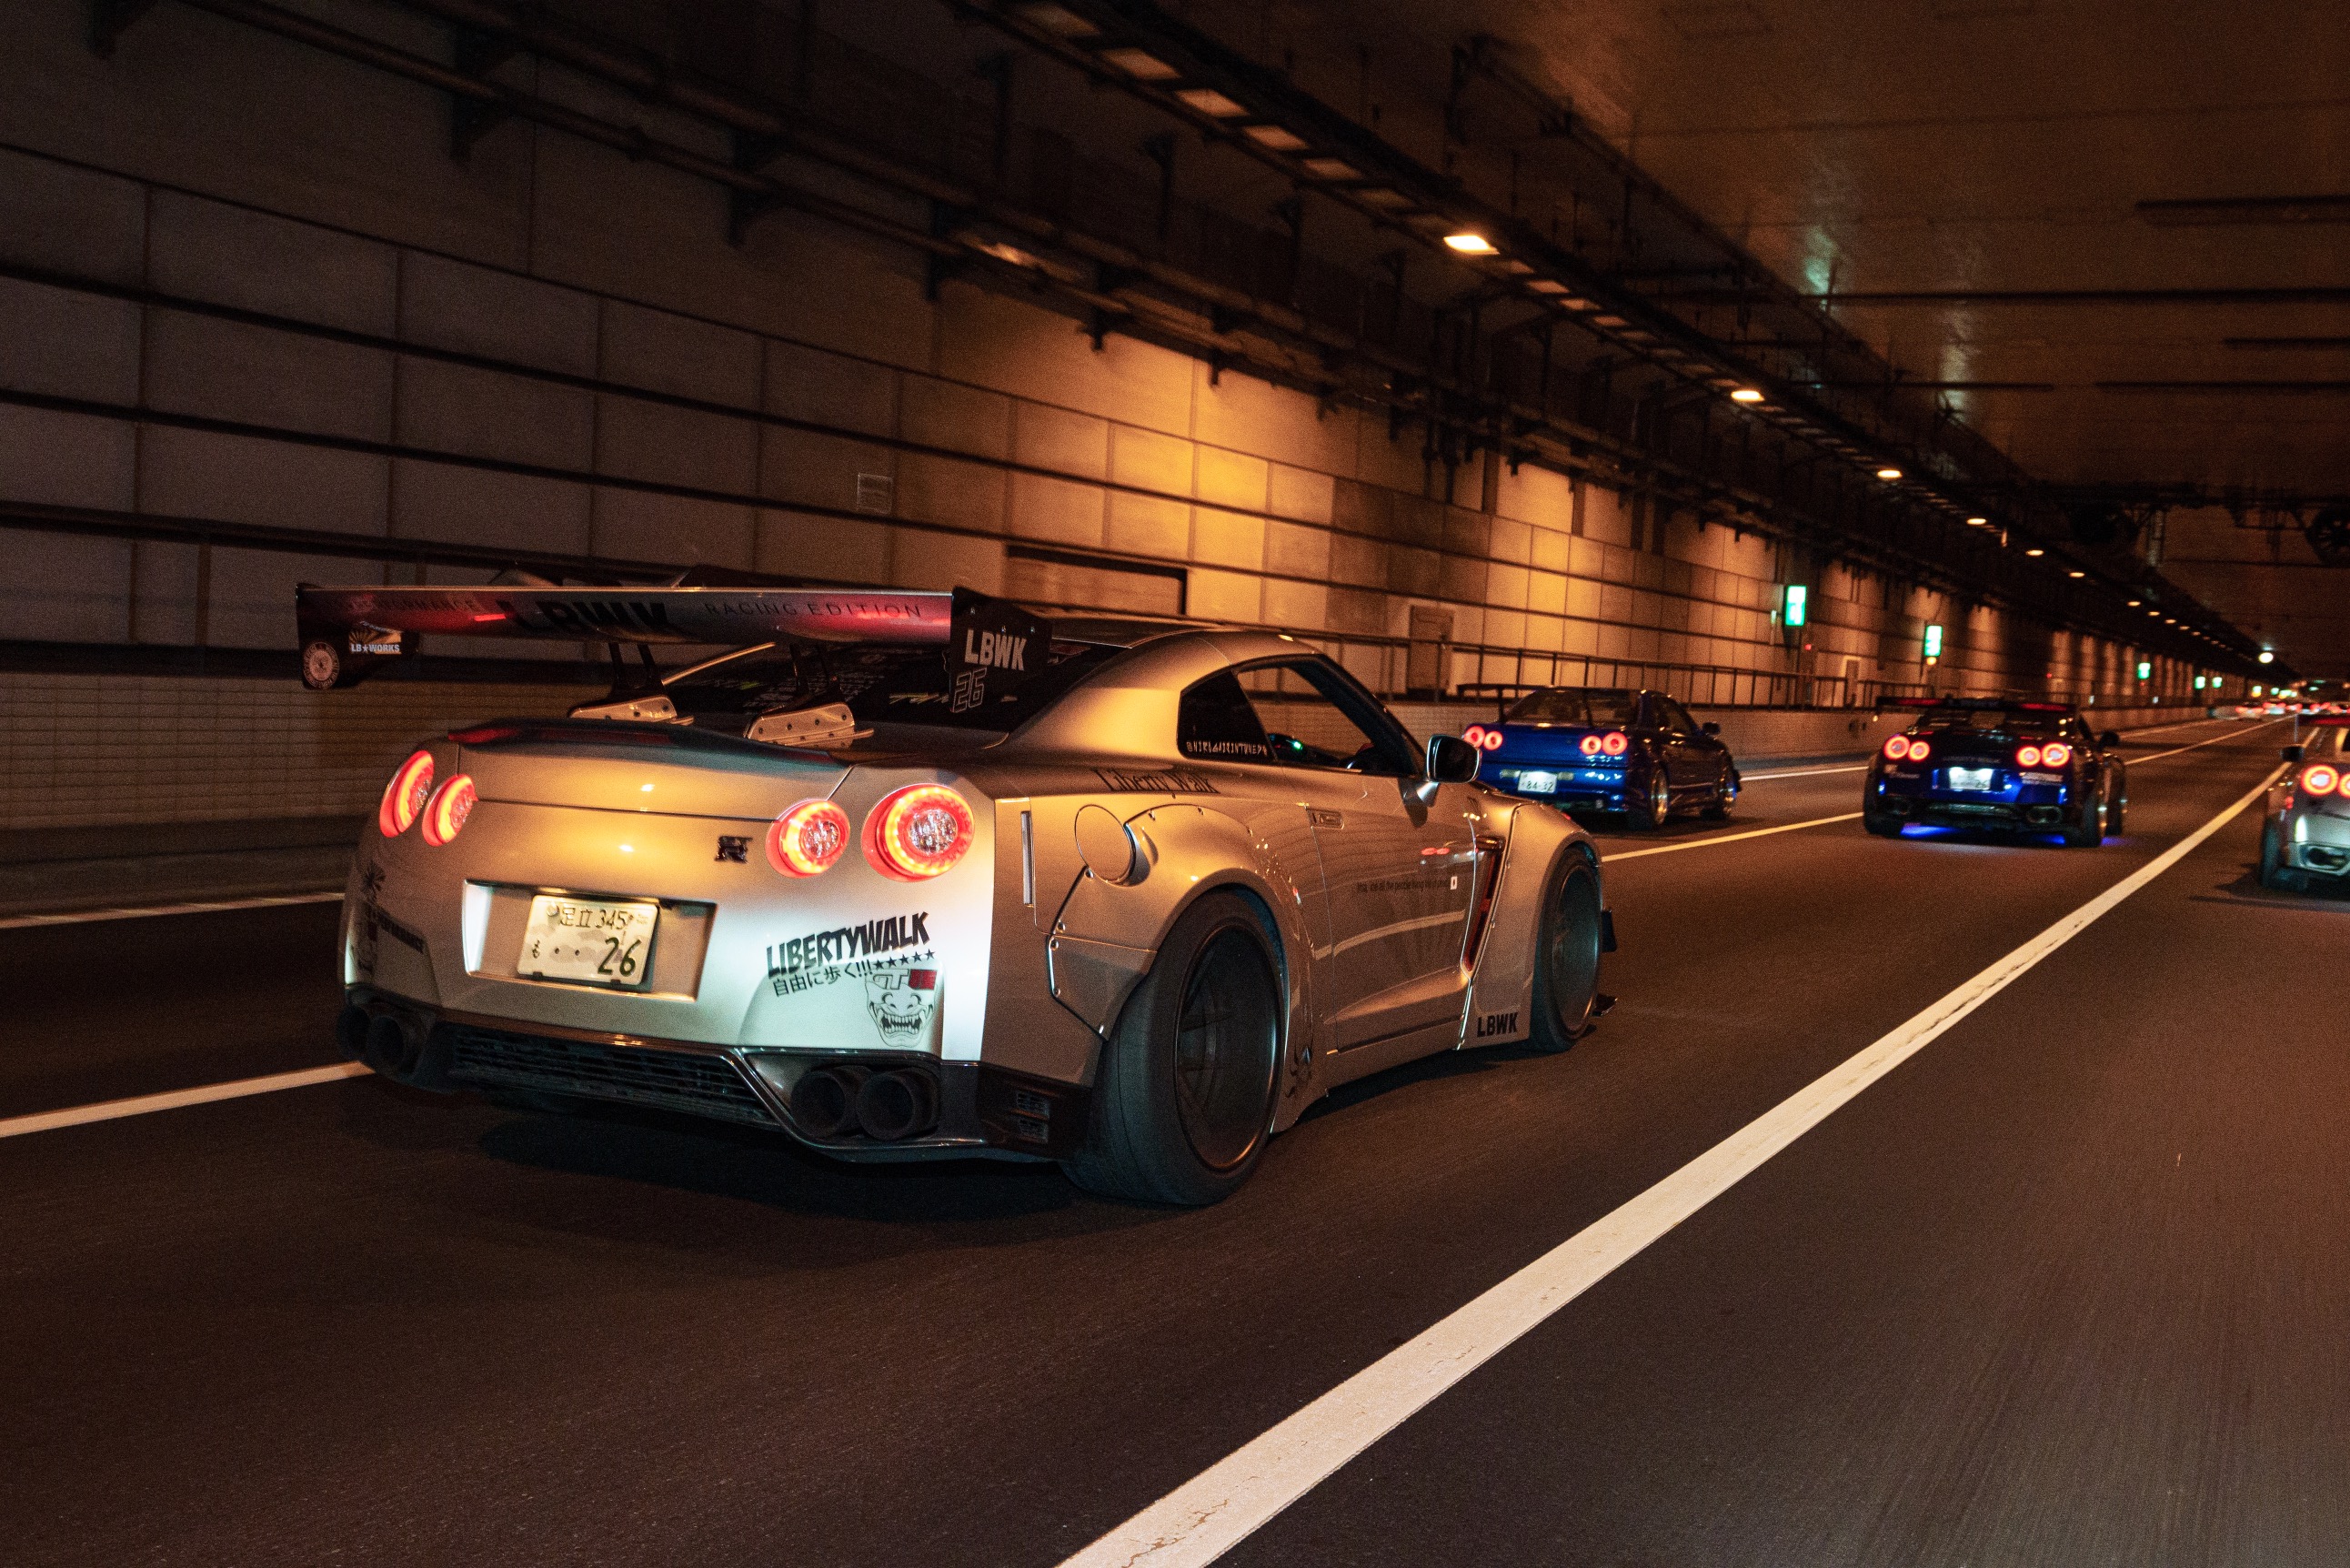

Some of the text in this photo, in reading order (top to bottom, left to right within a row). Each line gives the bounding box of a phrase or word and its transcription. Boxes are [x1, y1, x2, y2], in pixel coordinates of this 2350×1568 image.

[704, 601, 922, 618] RACING EDITION
[964, 628, 1027, 671] LBWK
[950, 667, 987, 713] 26
[1095, 769, 1220, 795] Liberty Walk
[559, 904, 594, 928] 足立
[598, 937, 641, 977] 26
[1477, 1011, 1518, 1038] LBWK
